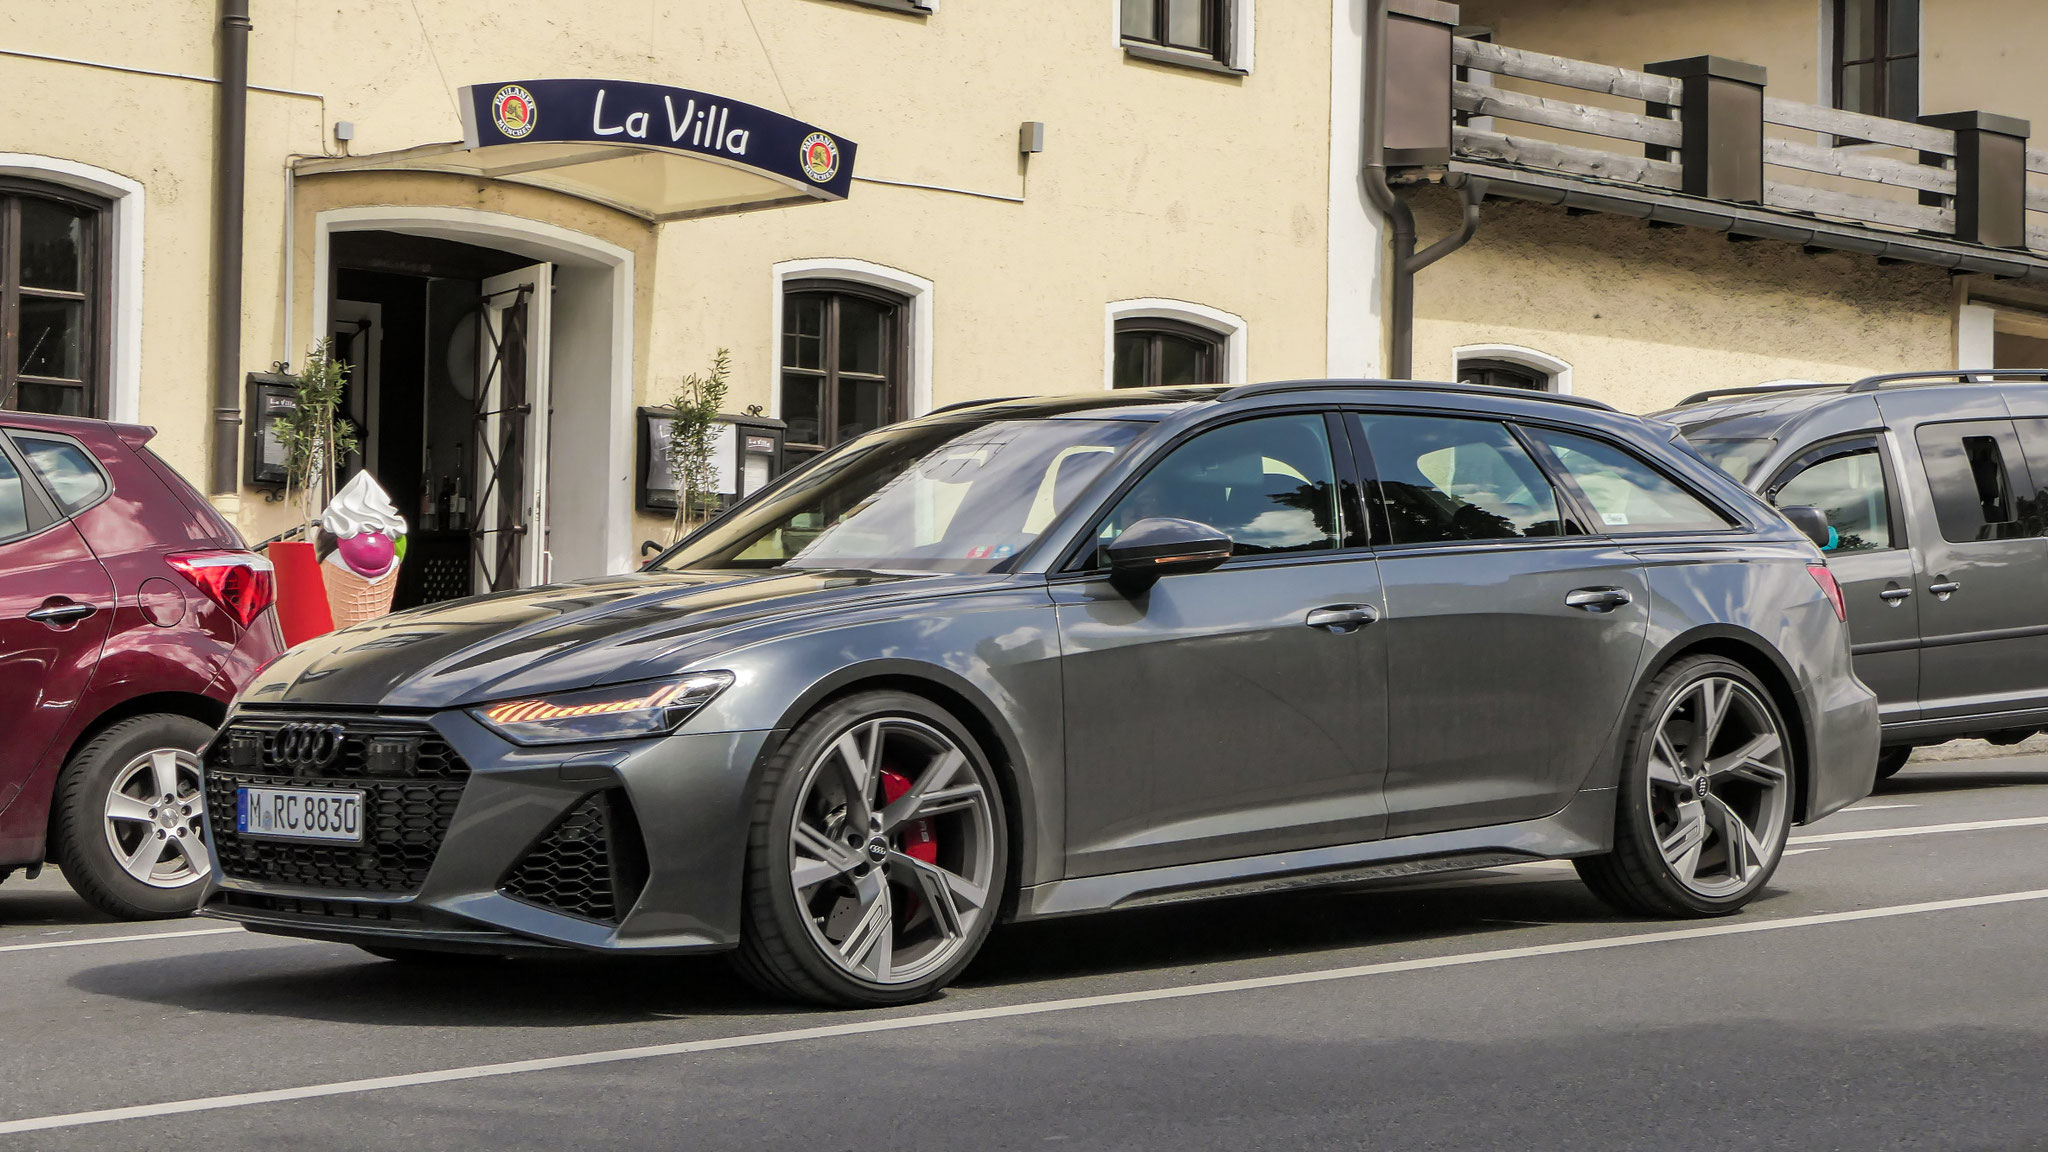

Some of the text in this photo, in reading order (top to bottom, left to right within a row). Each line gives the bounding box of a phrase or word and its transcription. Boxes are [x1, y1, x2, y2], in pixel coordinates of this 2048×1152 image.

[495, 87, 534, 110] PAULANER
[594, 89, 749, 156] La Villa
[802, 134, 837, 156] PAULANER
[250, 793, 357, 834] M RC 8830
